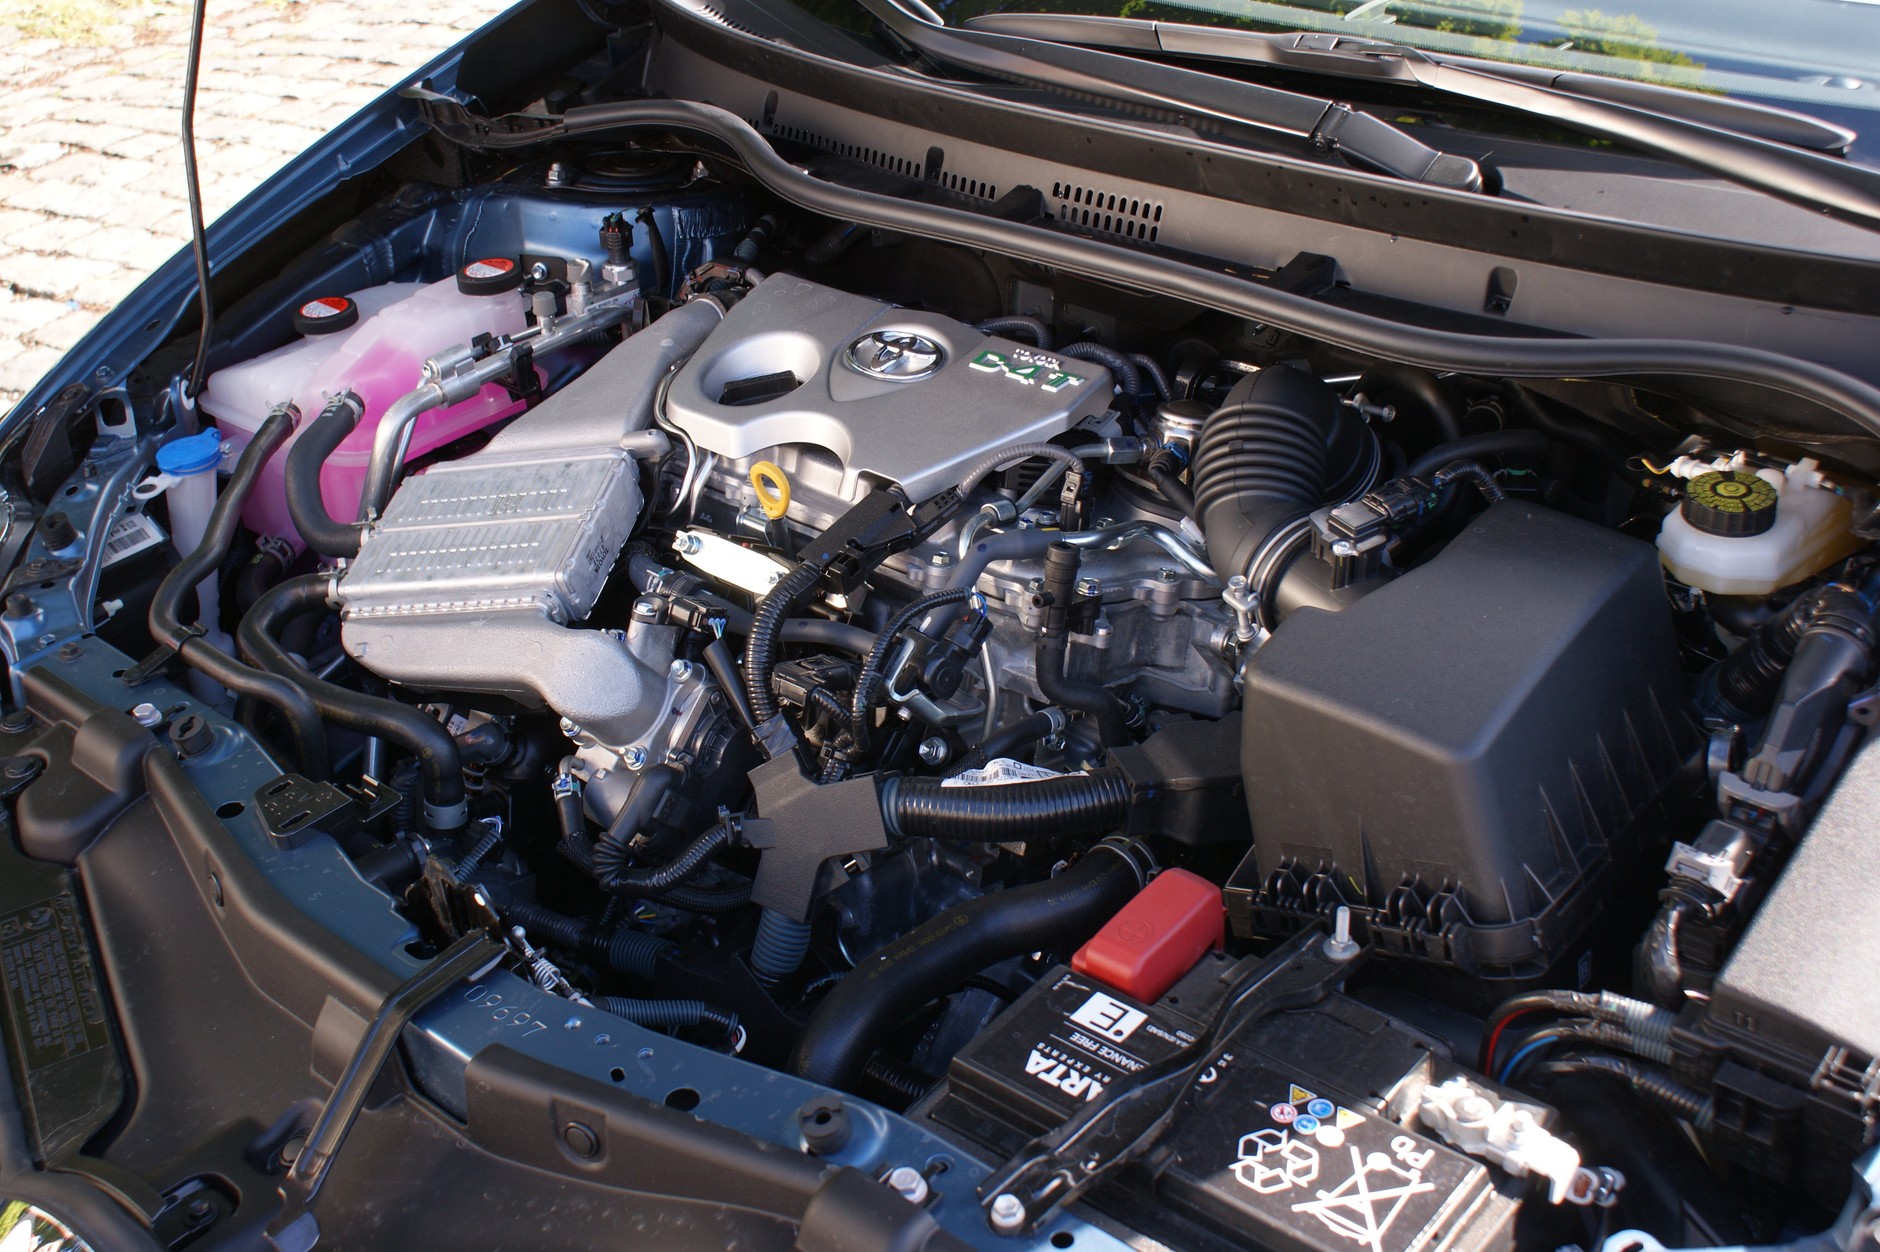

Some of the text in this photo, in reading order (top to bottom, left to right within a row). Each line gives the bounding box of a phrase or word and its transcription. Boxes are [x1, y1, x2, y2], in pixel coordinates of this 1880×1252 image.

[463, 984, 548, 1038] 09697
[1036, 1041, 1092, 1073] EXPERTS
[1069, 1031, 1099, 1051] FREE
[1024, 1049, 1104, 1102] ARTA
[1390, 1135, 1436, 1171] Pb
